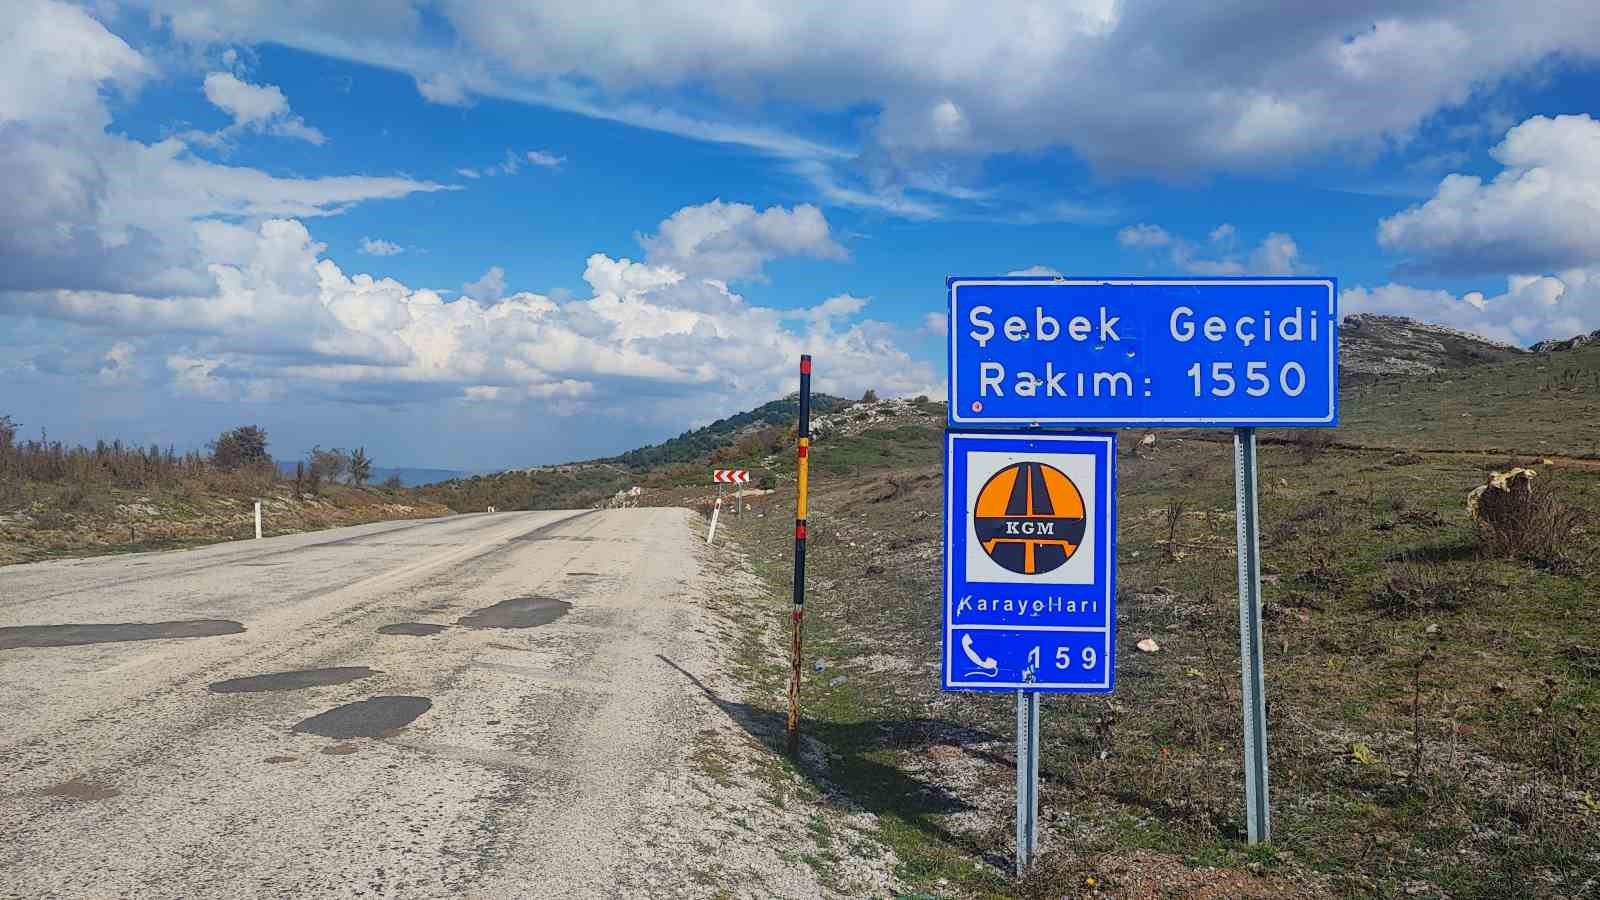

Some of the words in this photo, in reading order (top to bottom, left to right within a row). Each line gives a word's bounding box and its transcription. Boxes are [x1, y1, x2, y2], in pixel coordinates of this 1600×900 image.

[969, 306, 1120, 347] Şebek
[1169, 306, 1318, 347] Geçidi
[1187, 361, 1306, 397] 1550
[1006, 521, 1054, 535] KGM
[959, 595, 1097, 614] Karayolları
[1028, 645, 1097, 670] 159
